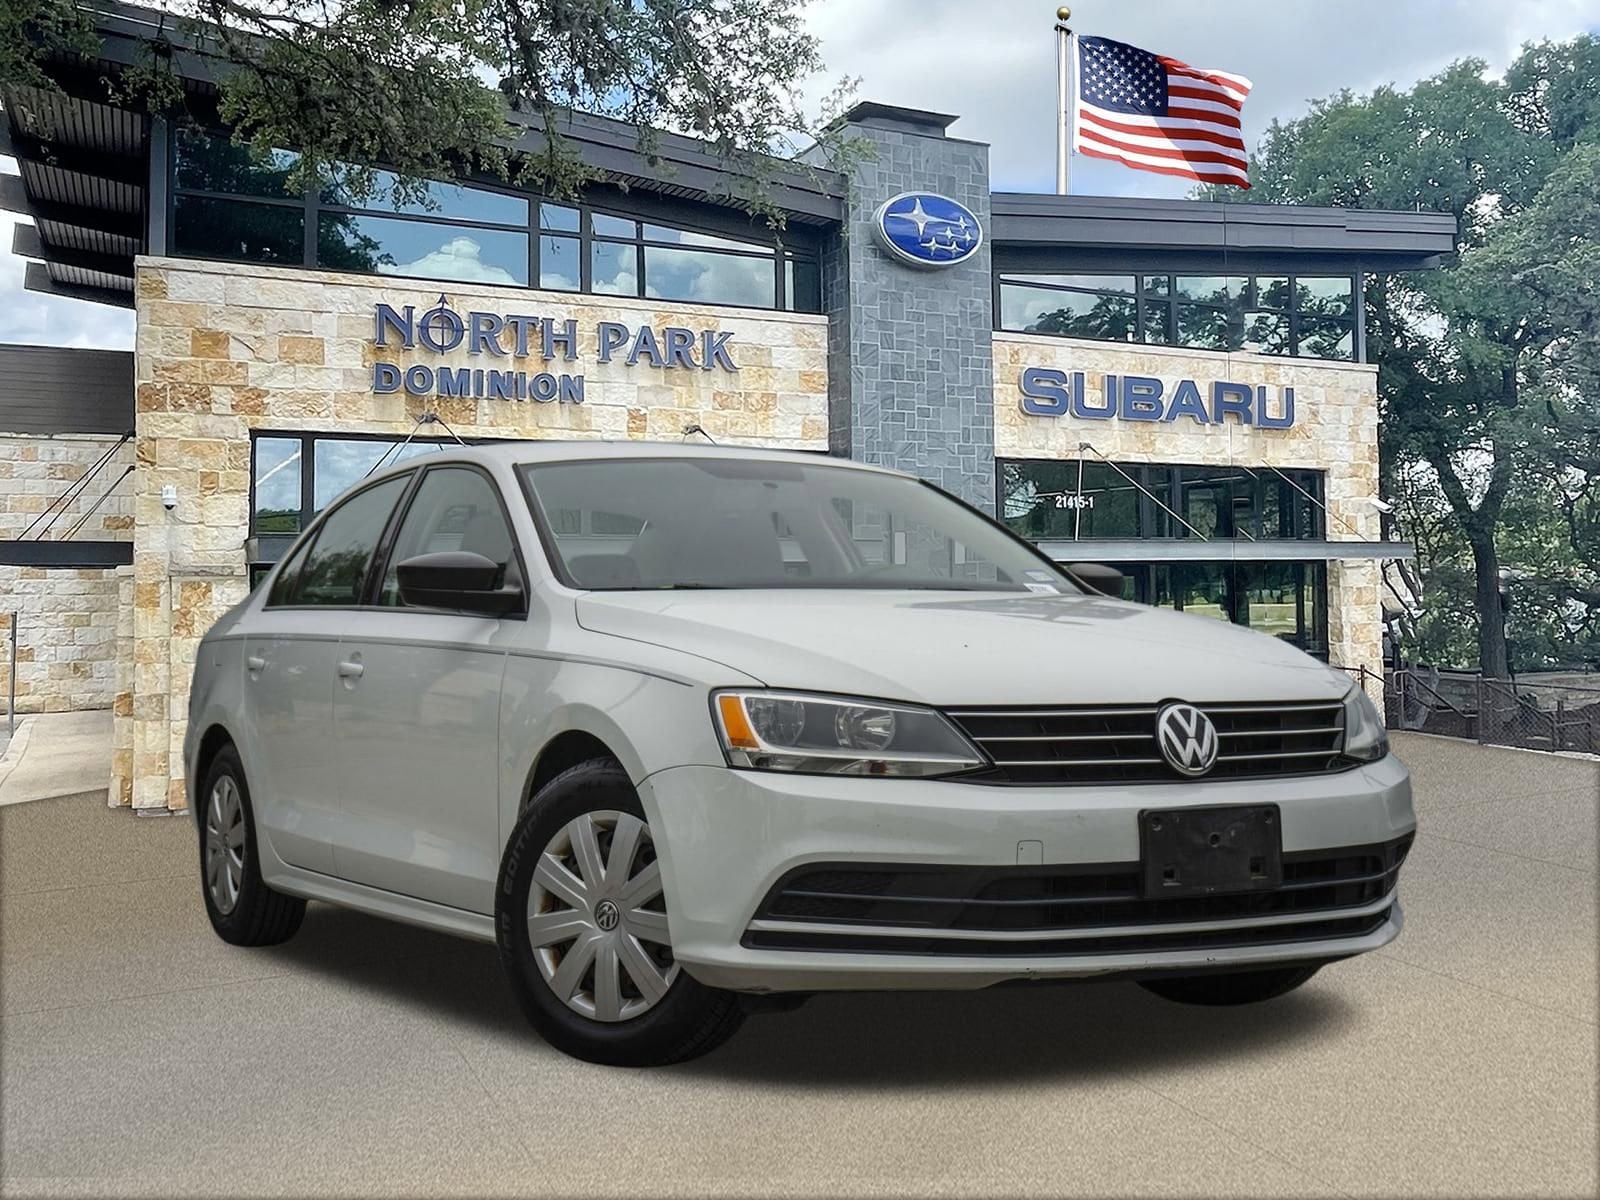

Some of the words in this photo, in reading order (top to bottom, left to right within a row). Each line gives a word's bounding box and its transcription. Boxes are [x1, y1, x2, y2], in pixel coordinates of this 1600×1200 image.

[373, 300, 579, 362] NORTH
[597, 321, 740, 372] PARK
[372, 362, 585, 403] DOMINION
[1019, 367, 1295, 430] SUBARU
[1055, 495, 1094, 509] 21415-1
